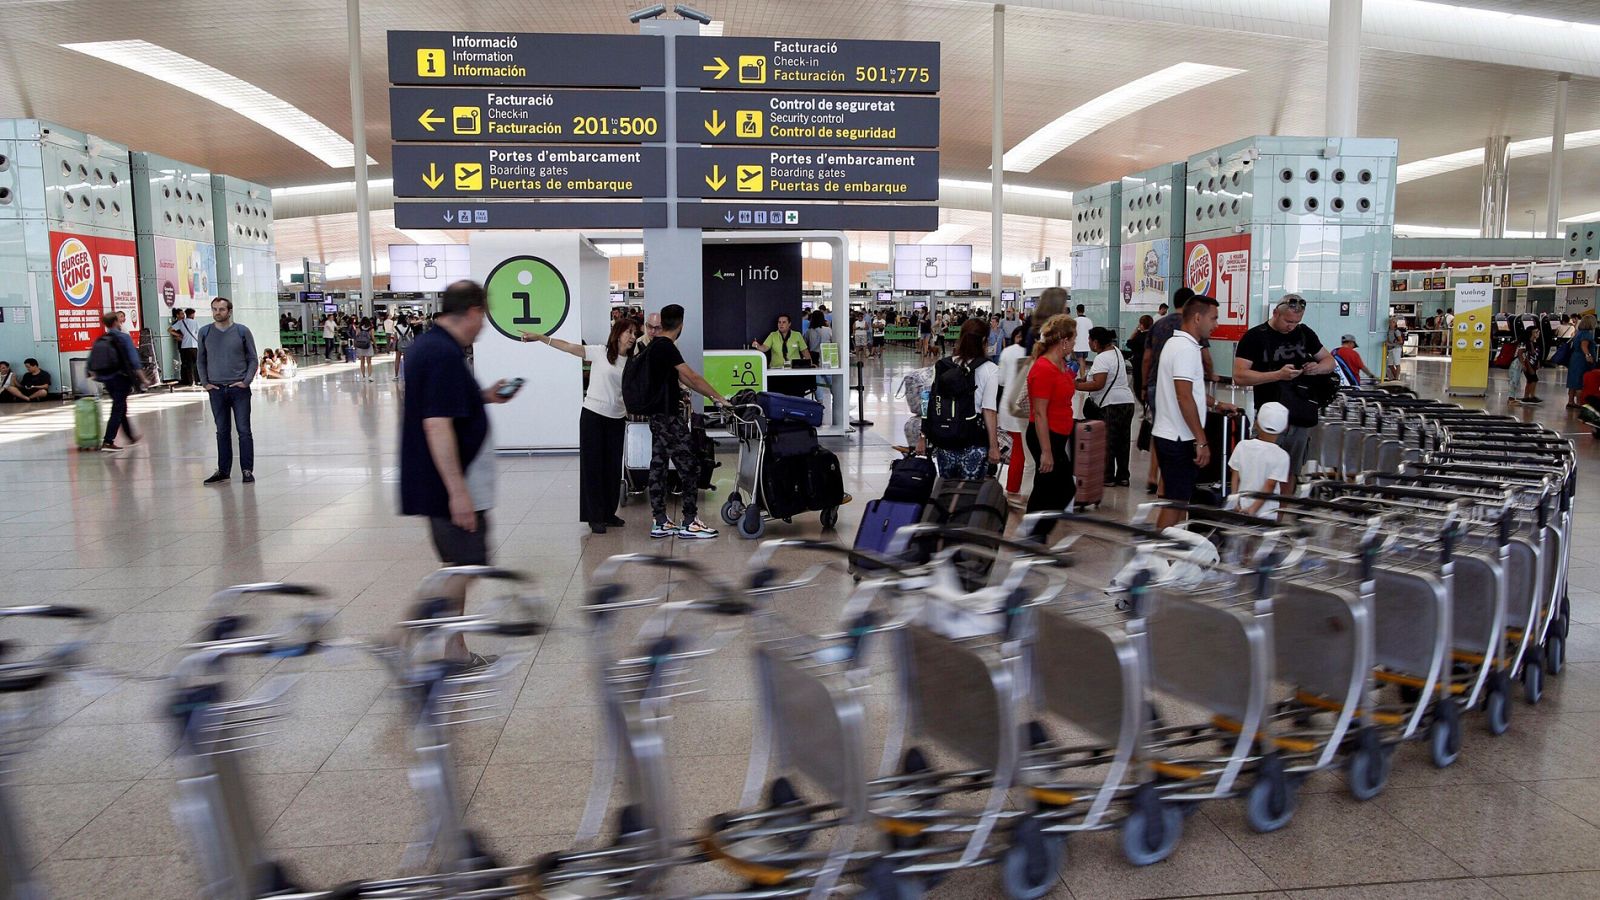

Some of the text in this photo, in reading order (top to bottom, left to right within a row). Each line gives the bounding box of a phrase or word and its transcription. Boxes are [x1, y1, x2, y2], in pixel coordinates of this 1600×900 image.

[453, 36, 517, 48] Informació
[775, 41, 837, 53] Facturació
[453, 51, 513, 61] Information
[774, 56, 818, 66] Check-in
[454, 64, 525, 76] Información
[775, 70, 844, 81] Facturación
[856, 67, 887, 81] 501
[897, 68, 929, 82] 775
[488, 93, 553, 105] Facturació
[770, 98, 895, 113] Control de seguretat
[488, 108, 528, 118] Check-in
[770, 113, 843, 124] Security control
[489, 122, 561, 133] Facturación
[574, 117, 609, 134] 201
[620, 118, 657, 135] 500
[770, 126, 895, 140] Control de seguridad
[490, 150, 640, 162] Portes d'embarcament
[771, 153, 915, 165] Portes d'embarcament
[490, 165, 568, 176] Boarding gates
[771, 167, 845, 179] Boarding gates
[491, 178, 632, 192] Puertas de embarque
[771, 181, 906, 194] Puertas de embarque
[61, 251, 88, 273] BURGER
[1190, 253, 1209, 275] BURGER
[63, 262, 91, 291] KING
[748, 265, 779, 281] info
[1190, 264, 1210, 289] KING
[1460, 288, 1486, 297] vueling
